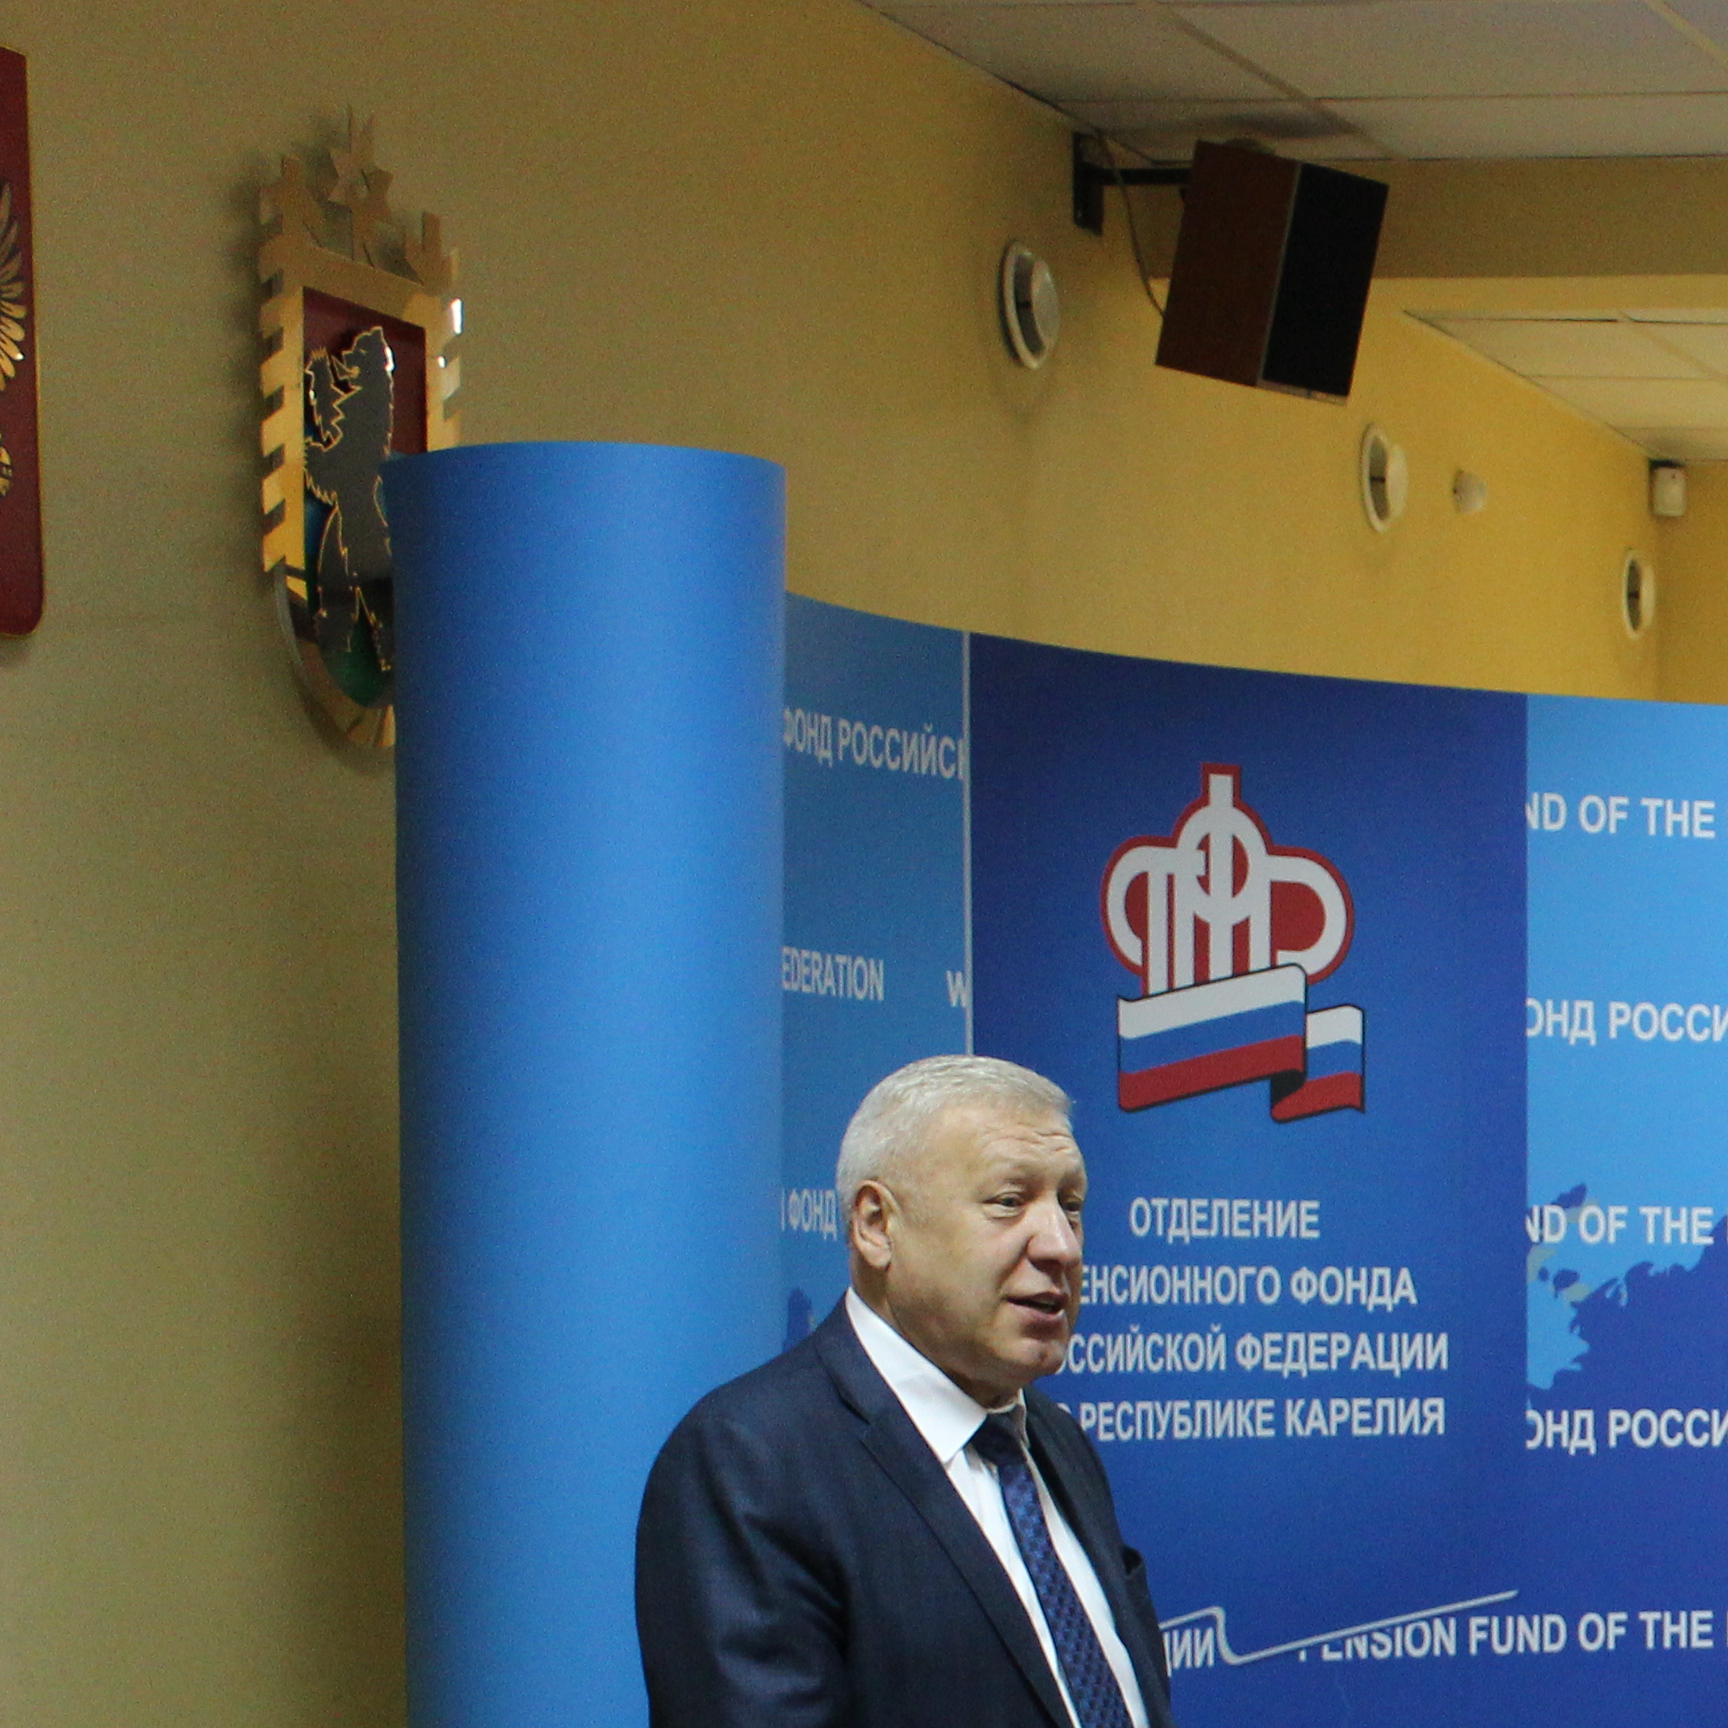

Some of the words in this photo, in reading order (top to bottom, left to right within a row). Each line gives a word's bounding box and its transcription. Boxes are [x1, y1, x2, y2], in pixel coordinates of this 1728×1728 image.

[1525, 792, 1567, 831] ND
[1578, 794, 1630, 834] OF
[1640, 797, 1716, 839] THE
[780, 945, 884, 1001] EDERATION
[1525, 997, 1597, 1046] ОНД
[1129, 1196, 1320, 1244] ОТДЕЛЕНИЕ
[1525, 1204, 1569, 1244] ND
[1576, 1203, 1629, 1245] OF
[1639, 1205, 1714, 1245] THE
[1080, 1263, 1282, 1305] ЕНСИОННОГО
[1289, 1265, 1418, 1312] ФОНДА
[1060, 1324, 1227, 1376] ССИЙСКОЙ
[1234, 1332, 1448, 1378] ФЕДЕРАЦИИ
[1079, 1398, 1276, 1442] РЕСПУБЛИКЕ
[1285, 1397, 1445, 1437] КАРЕЛИЯ
[1525, 1409, 1596, 1456] ОНД
[1468, 1614, 1567, 1655] FUND
[1577, 1611, 1628, 1652] OF
[1638, 1610, 1714, 1650] THE
